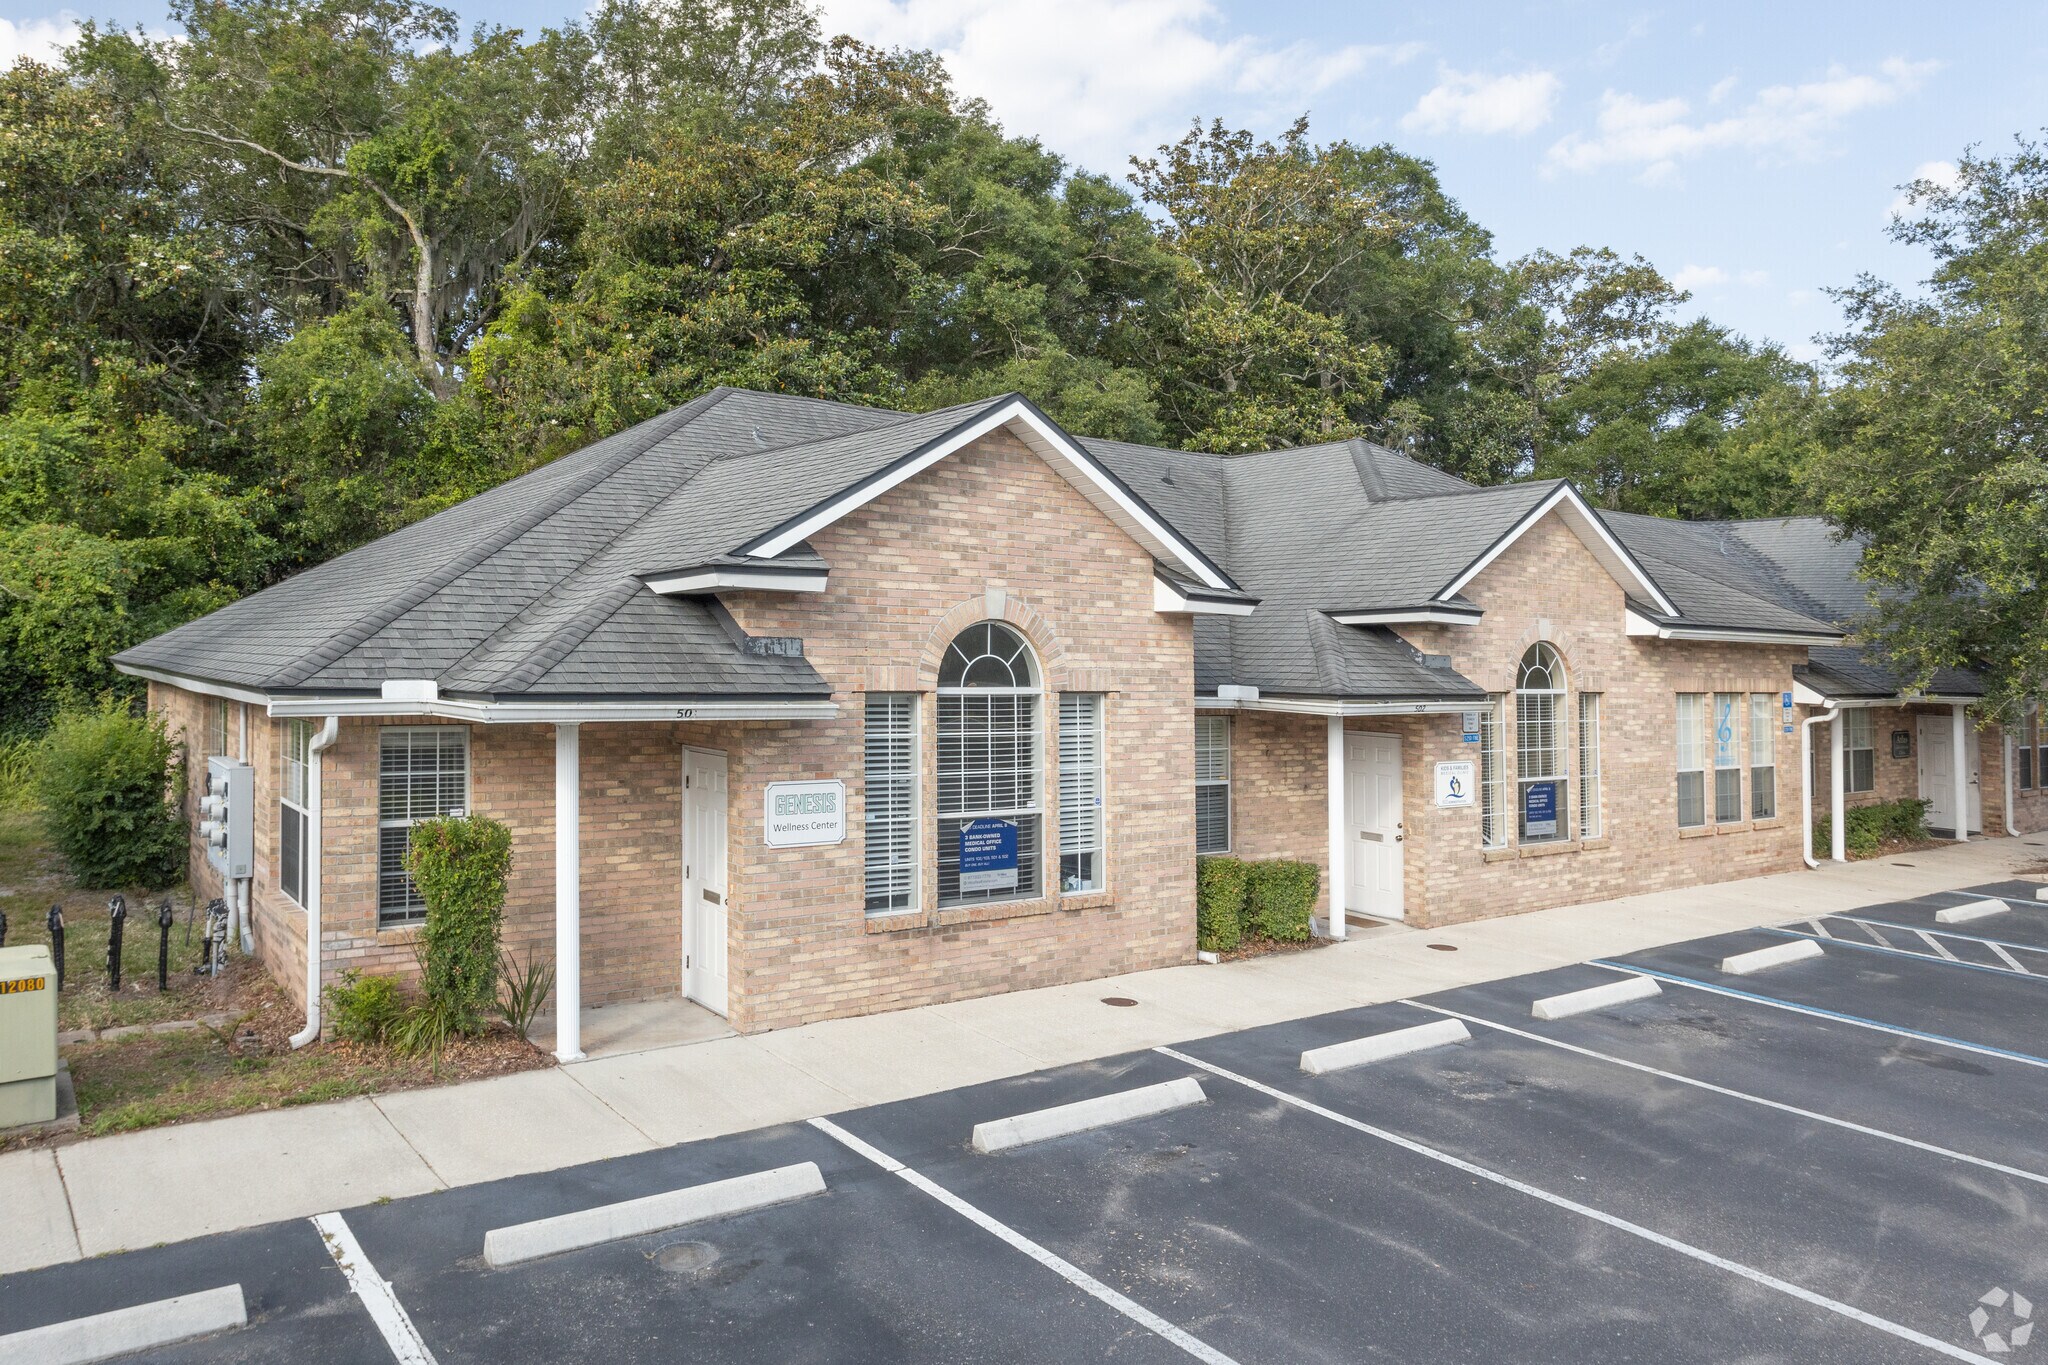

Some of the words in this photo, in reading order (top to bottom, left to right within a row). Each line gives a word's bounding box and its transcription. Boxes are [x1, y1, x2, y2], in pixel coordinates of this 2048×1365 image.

[677, 708, 697, 719] 50
[1414, 704, 1426, 712] 502
[775, 792, 837, 816] GENESIS
[773, 823, 809, 832] Wellness
[811, 821, 837, 830] Center
[1, 977, 45, 994] 12080
